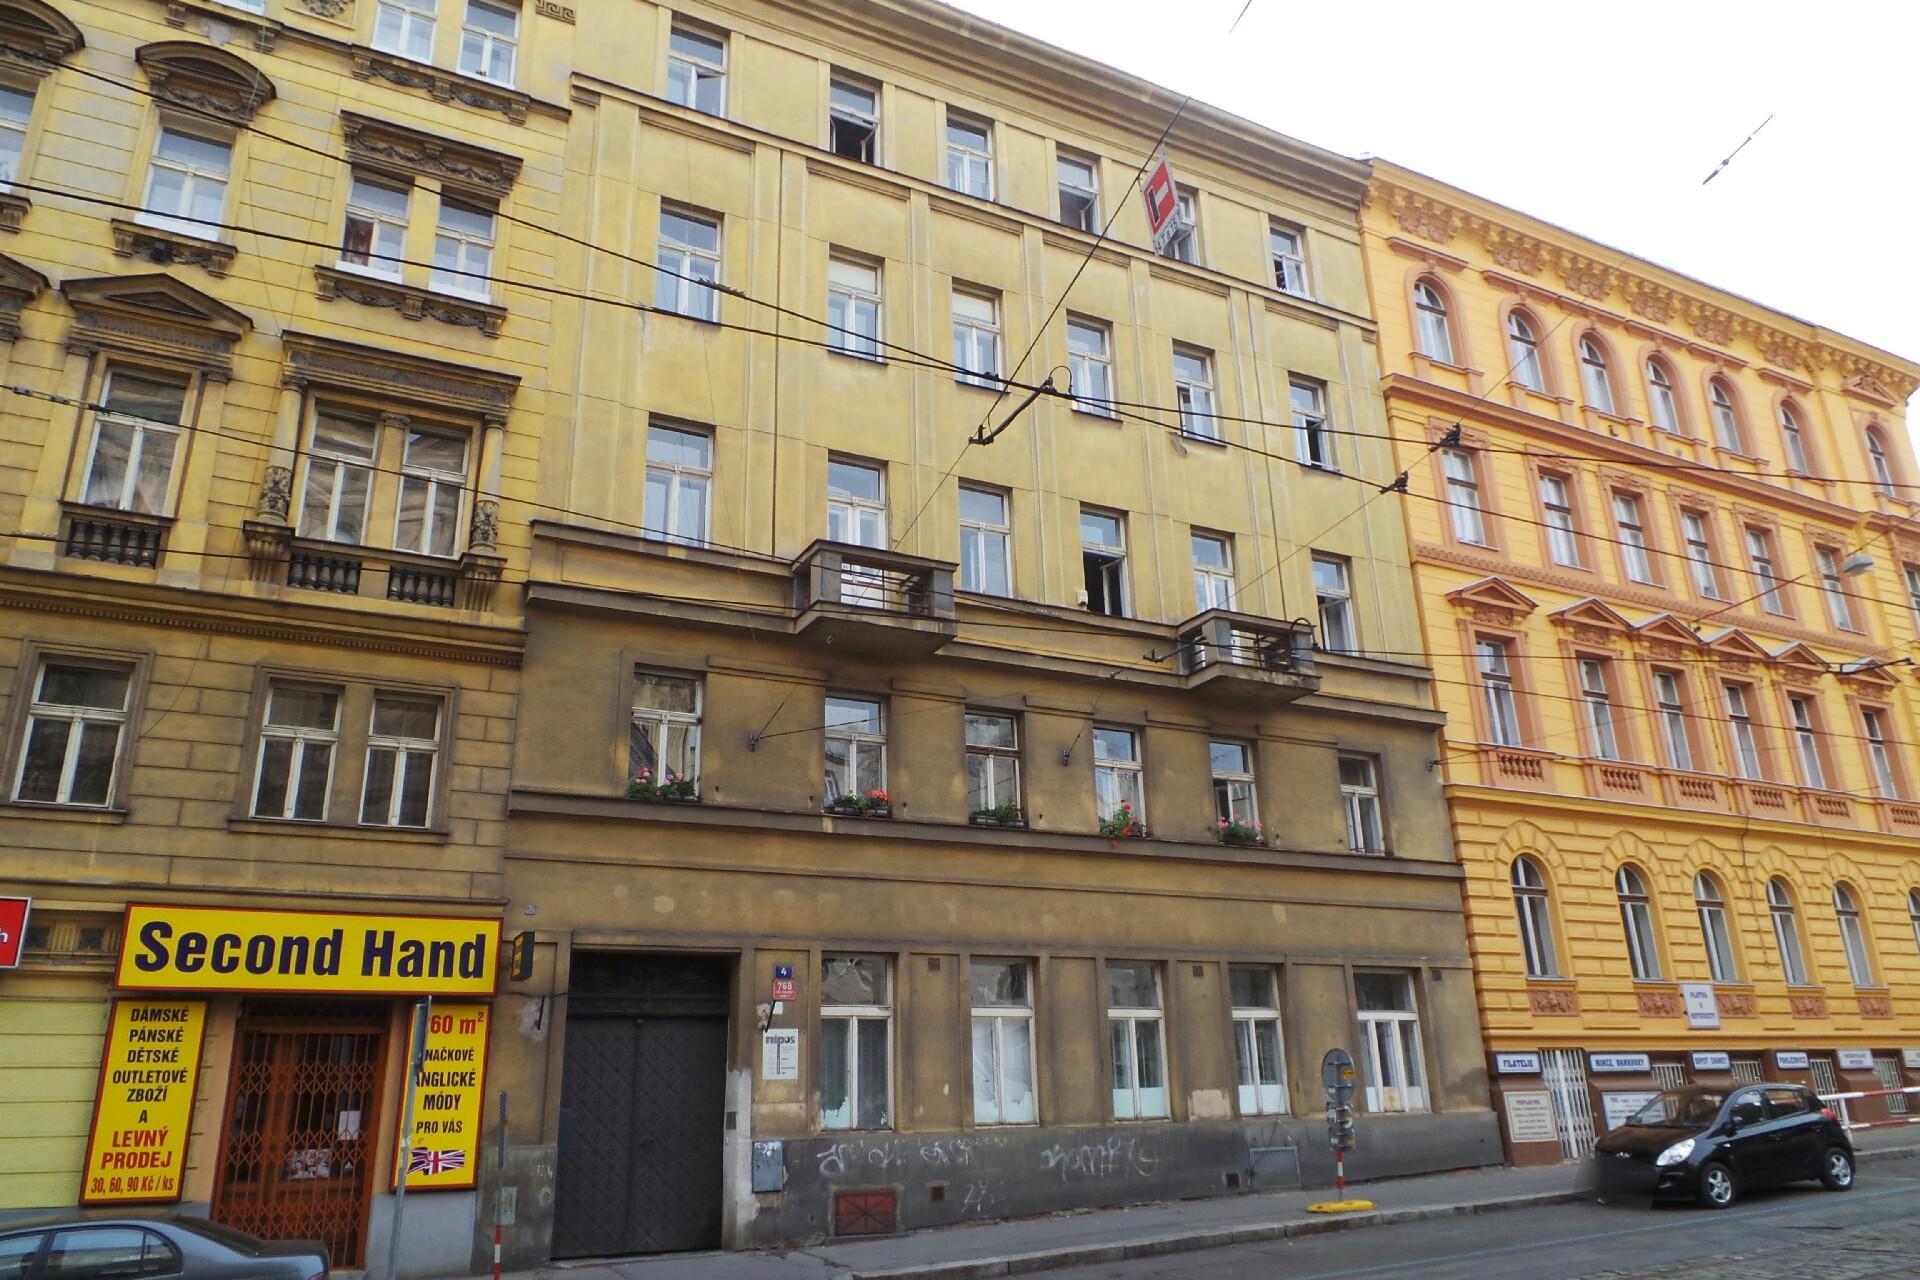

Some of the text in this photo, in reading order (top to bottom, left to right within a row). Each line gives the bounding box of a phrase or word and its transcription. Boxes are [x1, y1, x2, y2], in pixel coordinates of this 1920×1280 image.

[134, 921, 486, 979] Second Hand
[780, 967, 787, 977] 4
[130, 1005, 190, 1022] DÁMSKÉ
[129, 1025, 185, 1043] PÁNSKÉ
[127, 1046, 180, 1063] DĚTSKÉ
[424, 1046, 475, 1061] NAČKOVÉ
[112, 1067, 188, 1084] OUTLETOVÉ
[127, 1085, 168, 1102] ZBOŽÍ
[423, 1091, 462, 1111] MÓDY
[138, 1110, 148, 1124] A
[416, 1119, 463, 1134] PRO VÁS
[112, 1126, 169, 1147] LEVNÝ
[101, 1151, 173, 1170] PRODEJ
[91, 1175, 174, 1194] 30, 60, 90 Kč / ks
